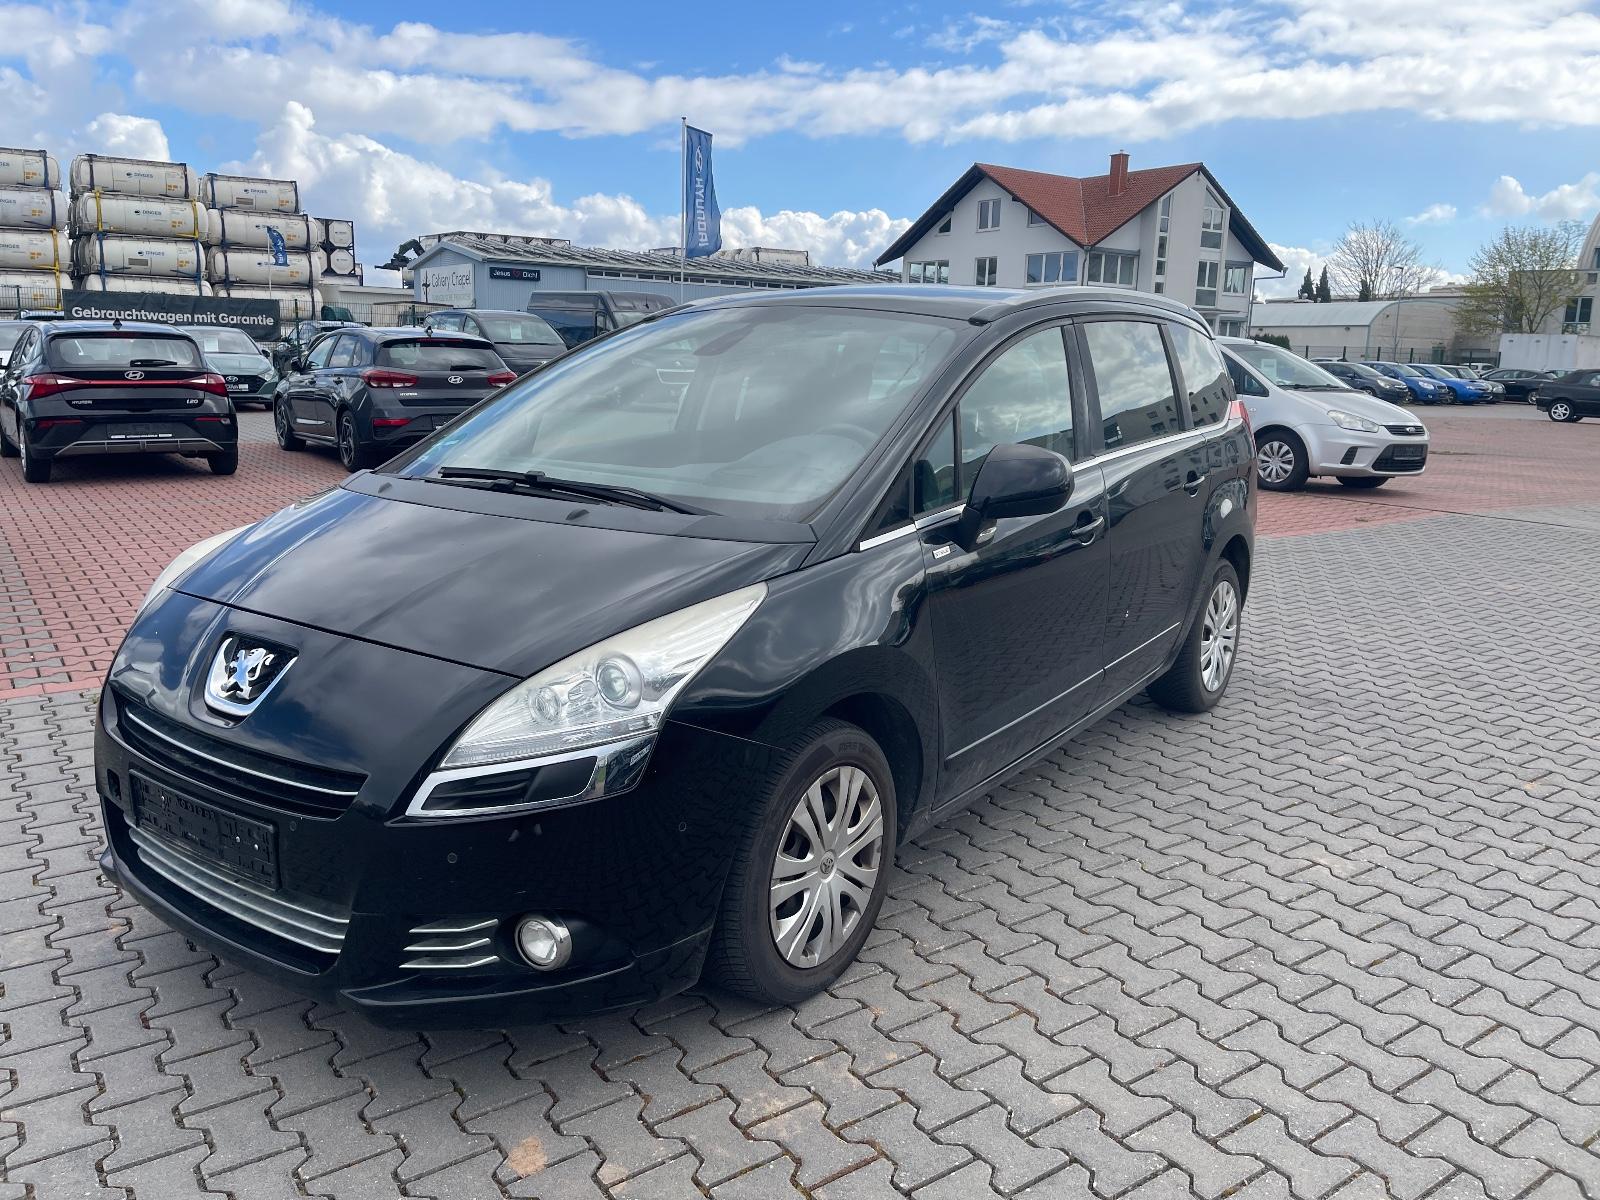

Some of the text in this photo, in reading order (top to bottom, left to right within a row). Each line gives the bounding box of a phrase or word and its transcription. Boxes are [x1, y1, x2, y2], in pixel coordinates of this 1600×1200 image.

[695, 177, 709, 246] HYUNDAI
[431, 270, 471, 290] Calvary Chapel
[493, 269, 511, 277] Jesus
[71, 306, 275, 326] Gebrauchtwagen mit Garantie
